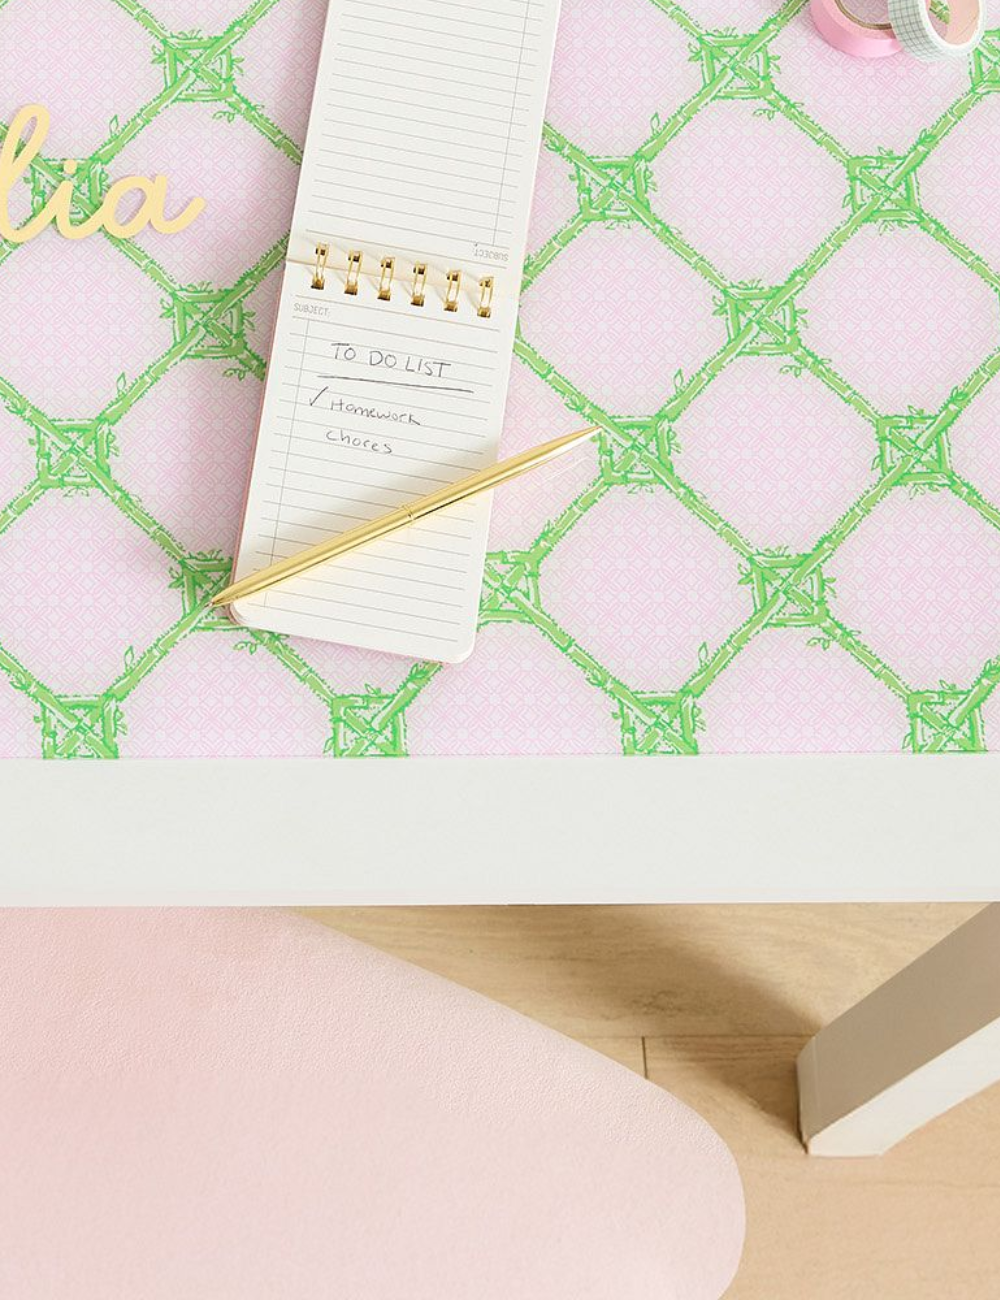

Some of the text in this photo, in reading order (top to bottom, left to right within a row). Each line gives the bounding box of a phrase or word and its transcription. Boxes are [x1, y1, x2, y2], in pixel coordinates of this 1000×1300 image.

[331, 342, 452, 378] TO DO LIST
[330, 398, 421, 426] Homework
